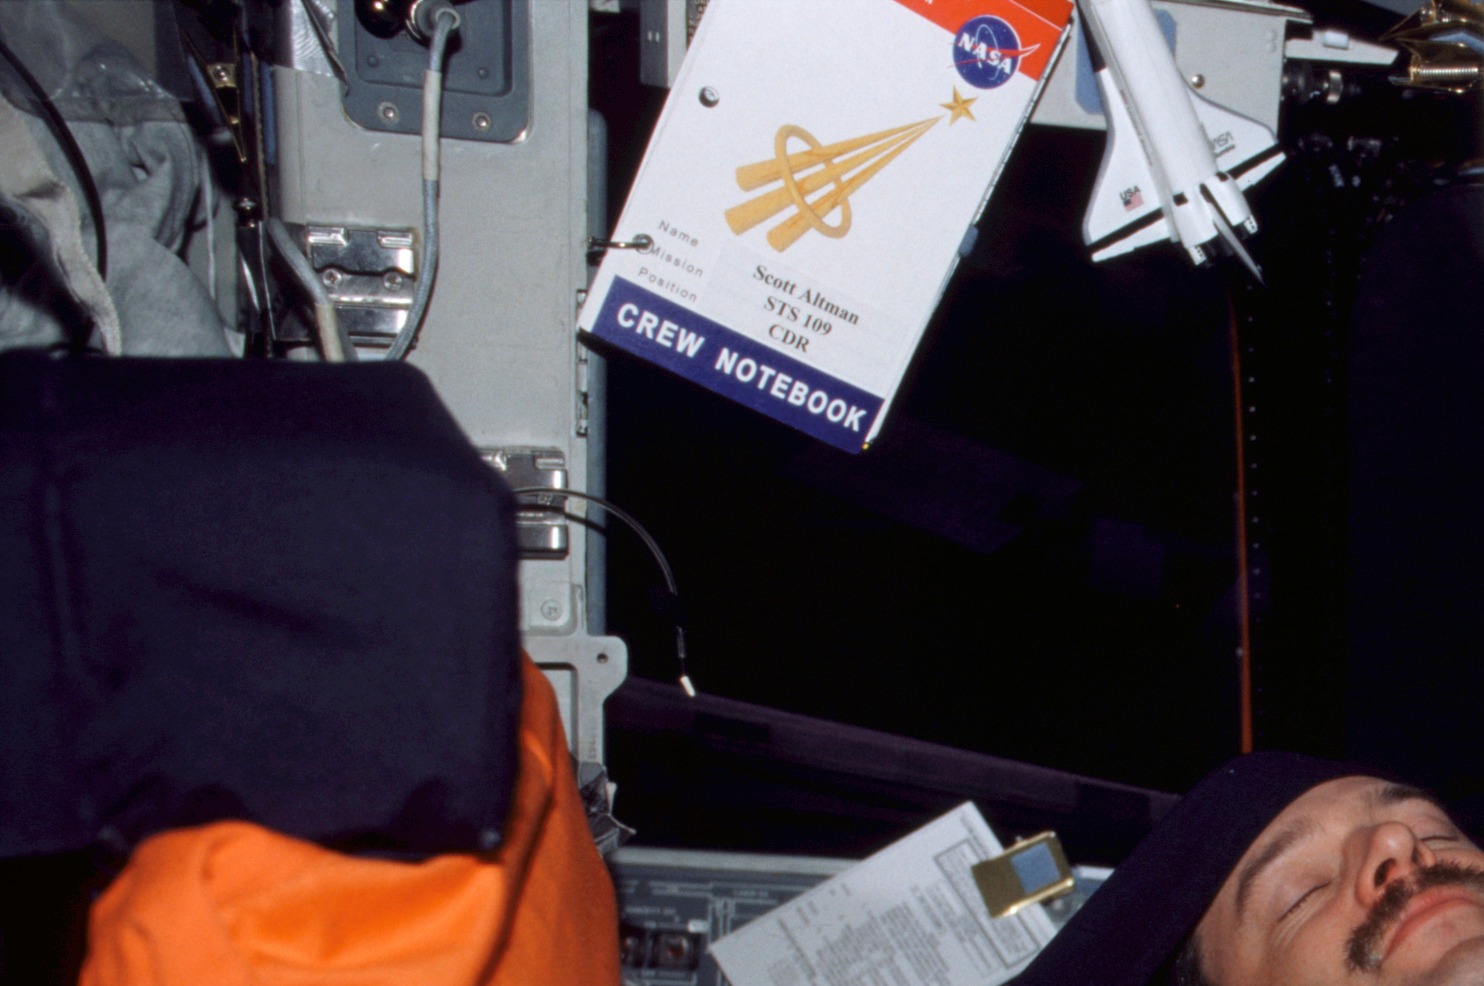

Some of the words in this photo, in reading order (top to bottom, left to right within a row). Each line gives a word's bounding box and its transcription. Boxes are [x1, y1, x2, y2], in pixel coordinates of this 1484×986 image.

[958, 32, 1012, 75] NASA
[1119, 185, 1142, 201] USA
[658, 220, 700, 248] Name
[650, 245, 704, 278] Mission
[638, 266, 698, 303] Position
[752, 264, 799, 296] Scott
[798, 288, 861, 325] Altman
[763, 295, 801, 322] STS
[803, 317, 833, 338] 109
[768, 323, 812, 353] CDR
[616, 303, 706, 359] CREW
[715, 347, 868, 433] NOTEBOOK
